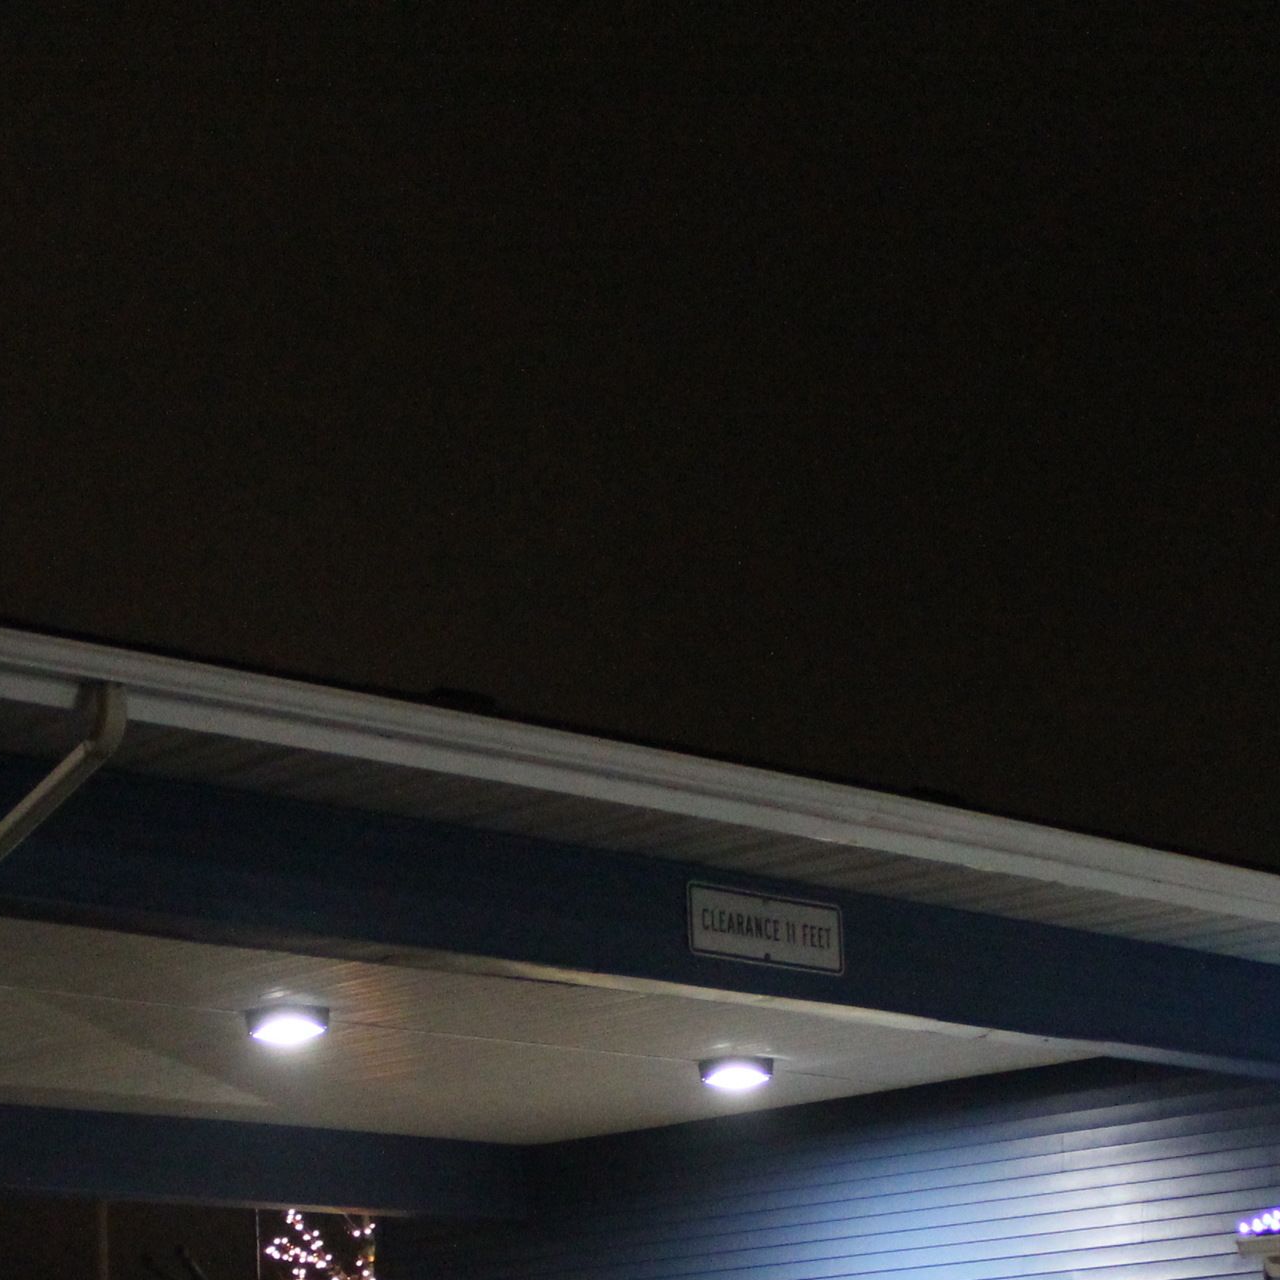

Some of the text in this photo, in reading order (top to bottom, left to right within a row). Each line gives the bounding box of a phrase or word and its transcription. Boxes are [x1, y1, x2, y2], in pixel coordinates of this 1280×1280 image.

[702, 908, 831, 949] CLEARANCE 11 FEET
